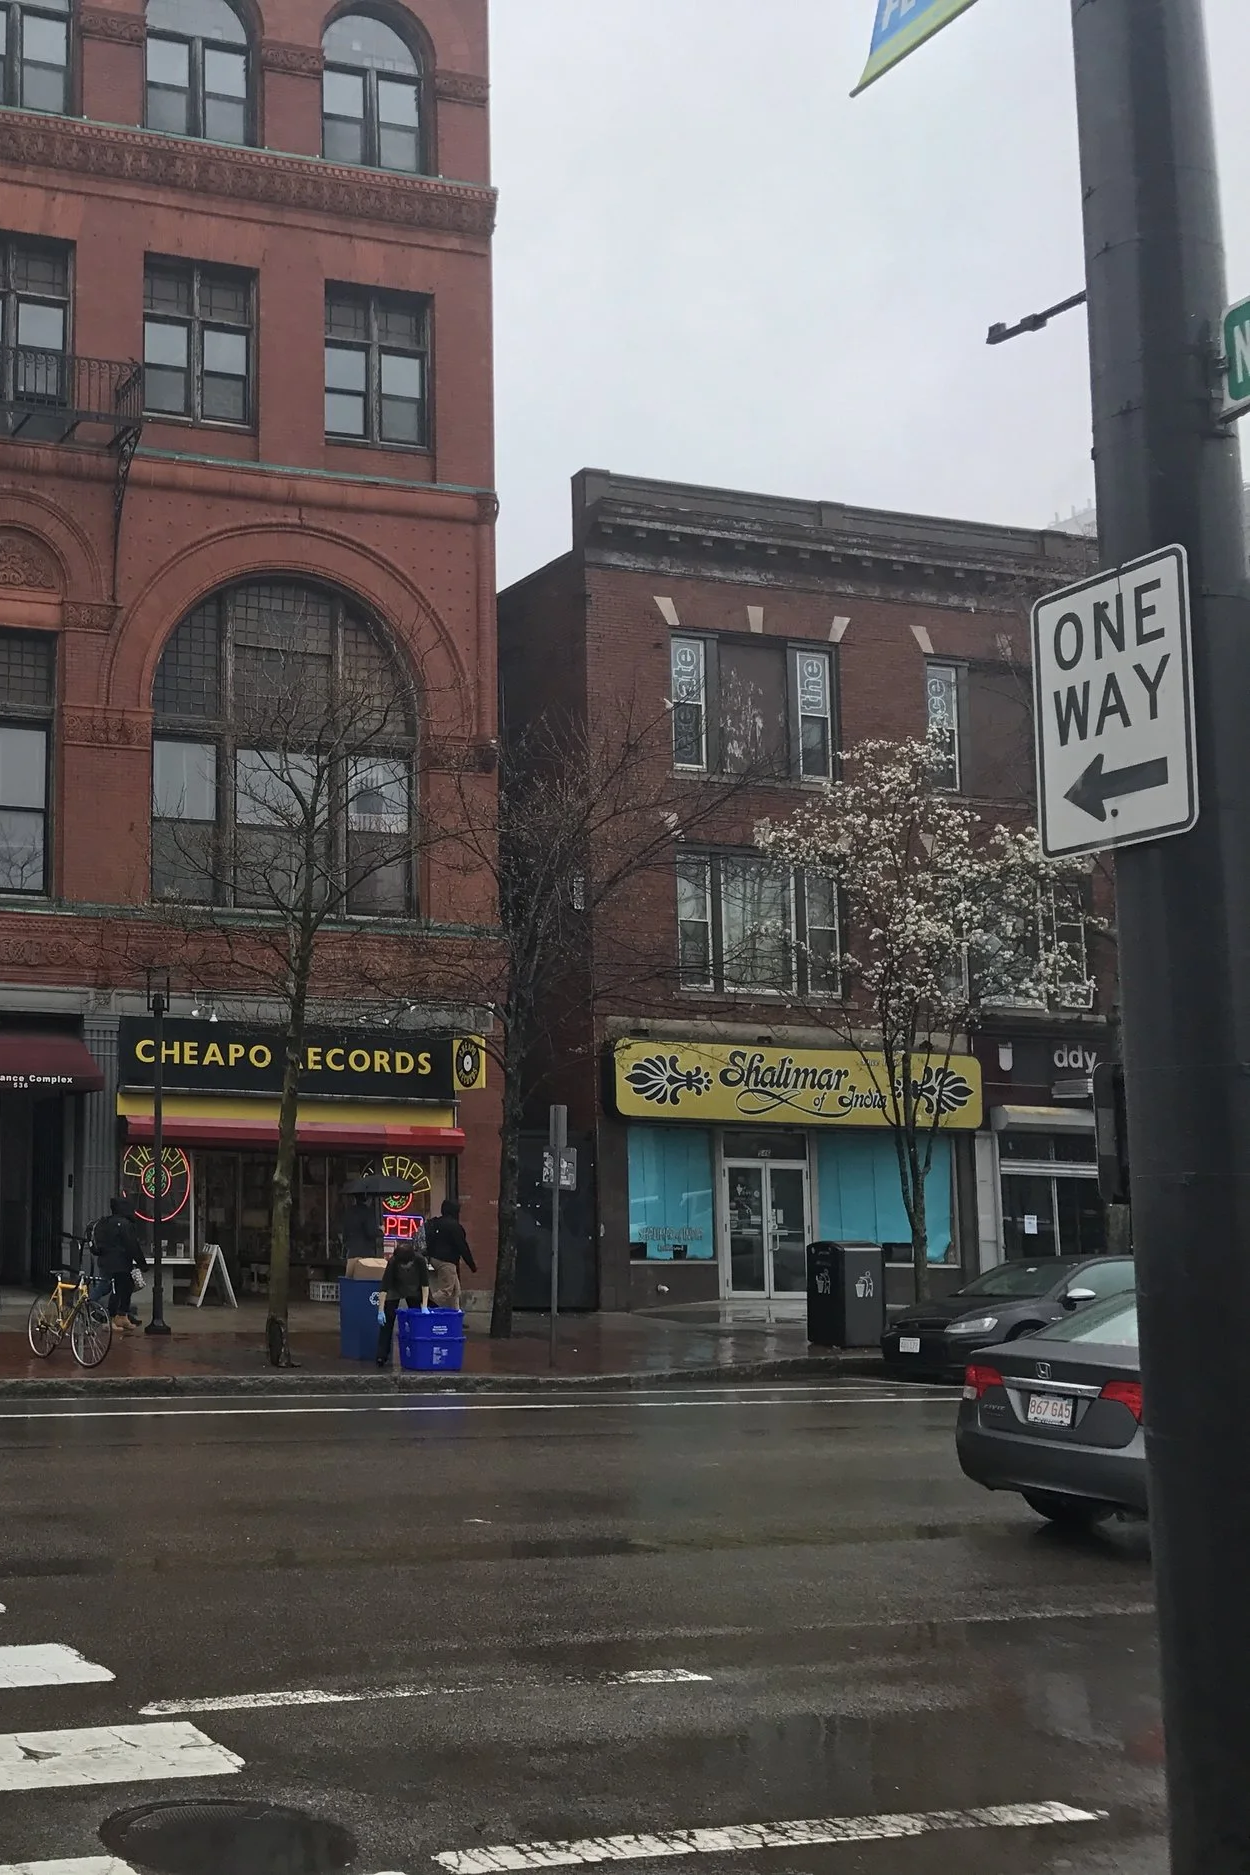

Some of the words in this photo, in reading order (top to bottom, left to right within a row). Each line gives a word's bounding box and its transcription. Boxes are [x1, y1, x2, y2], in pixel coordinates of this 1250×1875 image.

[1053, 578, 1166, 671] ONE
[800, 659, 823, 710] the
[1053, 653, 1171, 747] WAY
[135, 1039, 272, 1068] CHEAPO
[296, 1047, 432, 1075] ECORDS
[719, 1050, 850, 1092] Shalimar
[29, 1075, 73, 1084] Complex
[813, 1091, 827, 1111] of
[838, 1085, 887, 1110] India
[384, 1216, 419, 1237] PEN
[1029, 1399, 1050, 1415] 867
[1051, 1401, 1071, 1418] GA5
